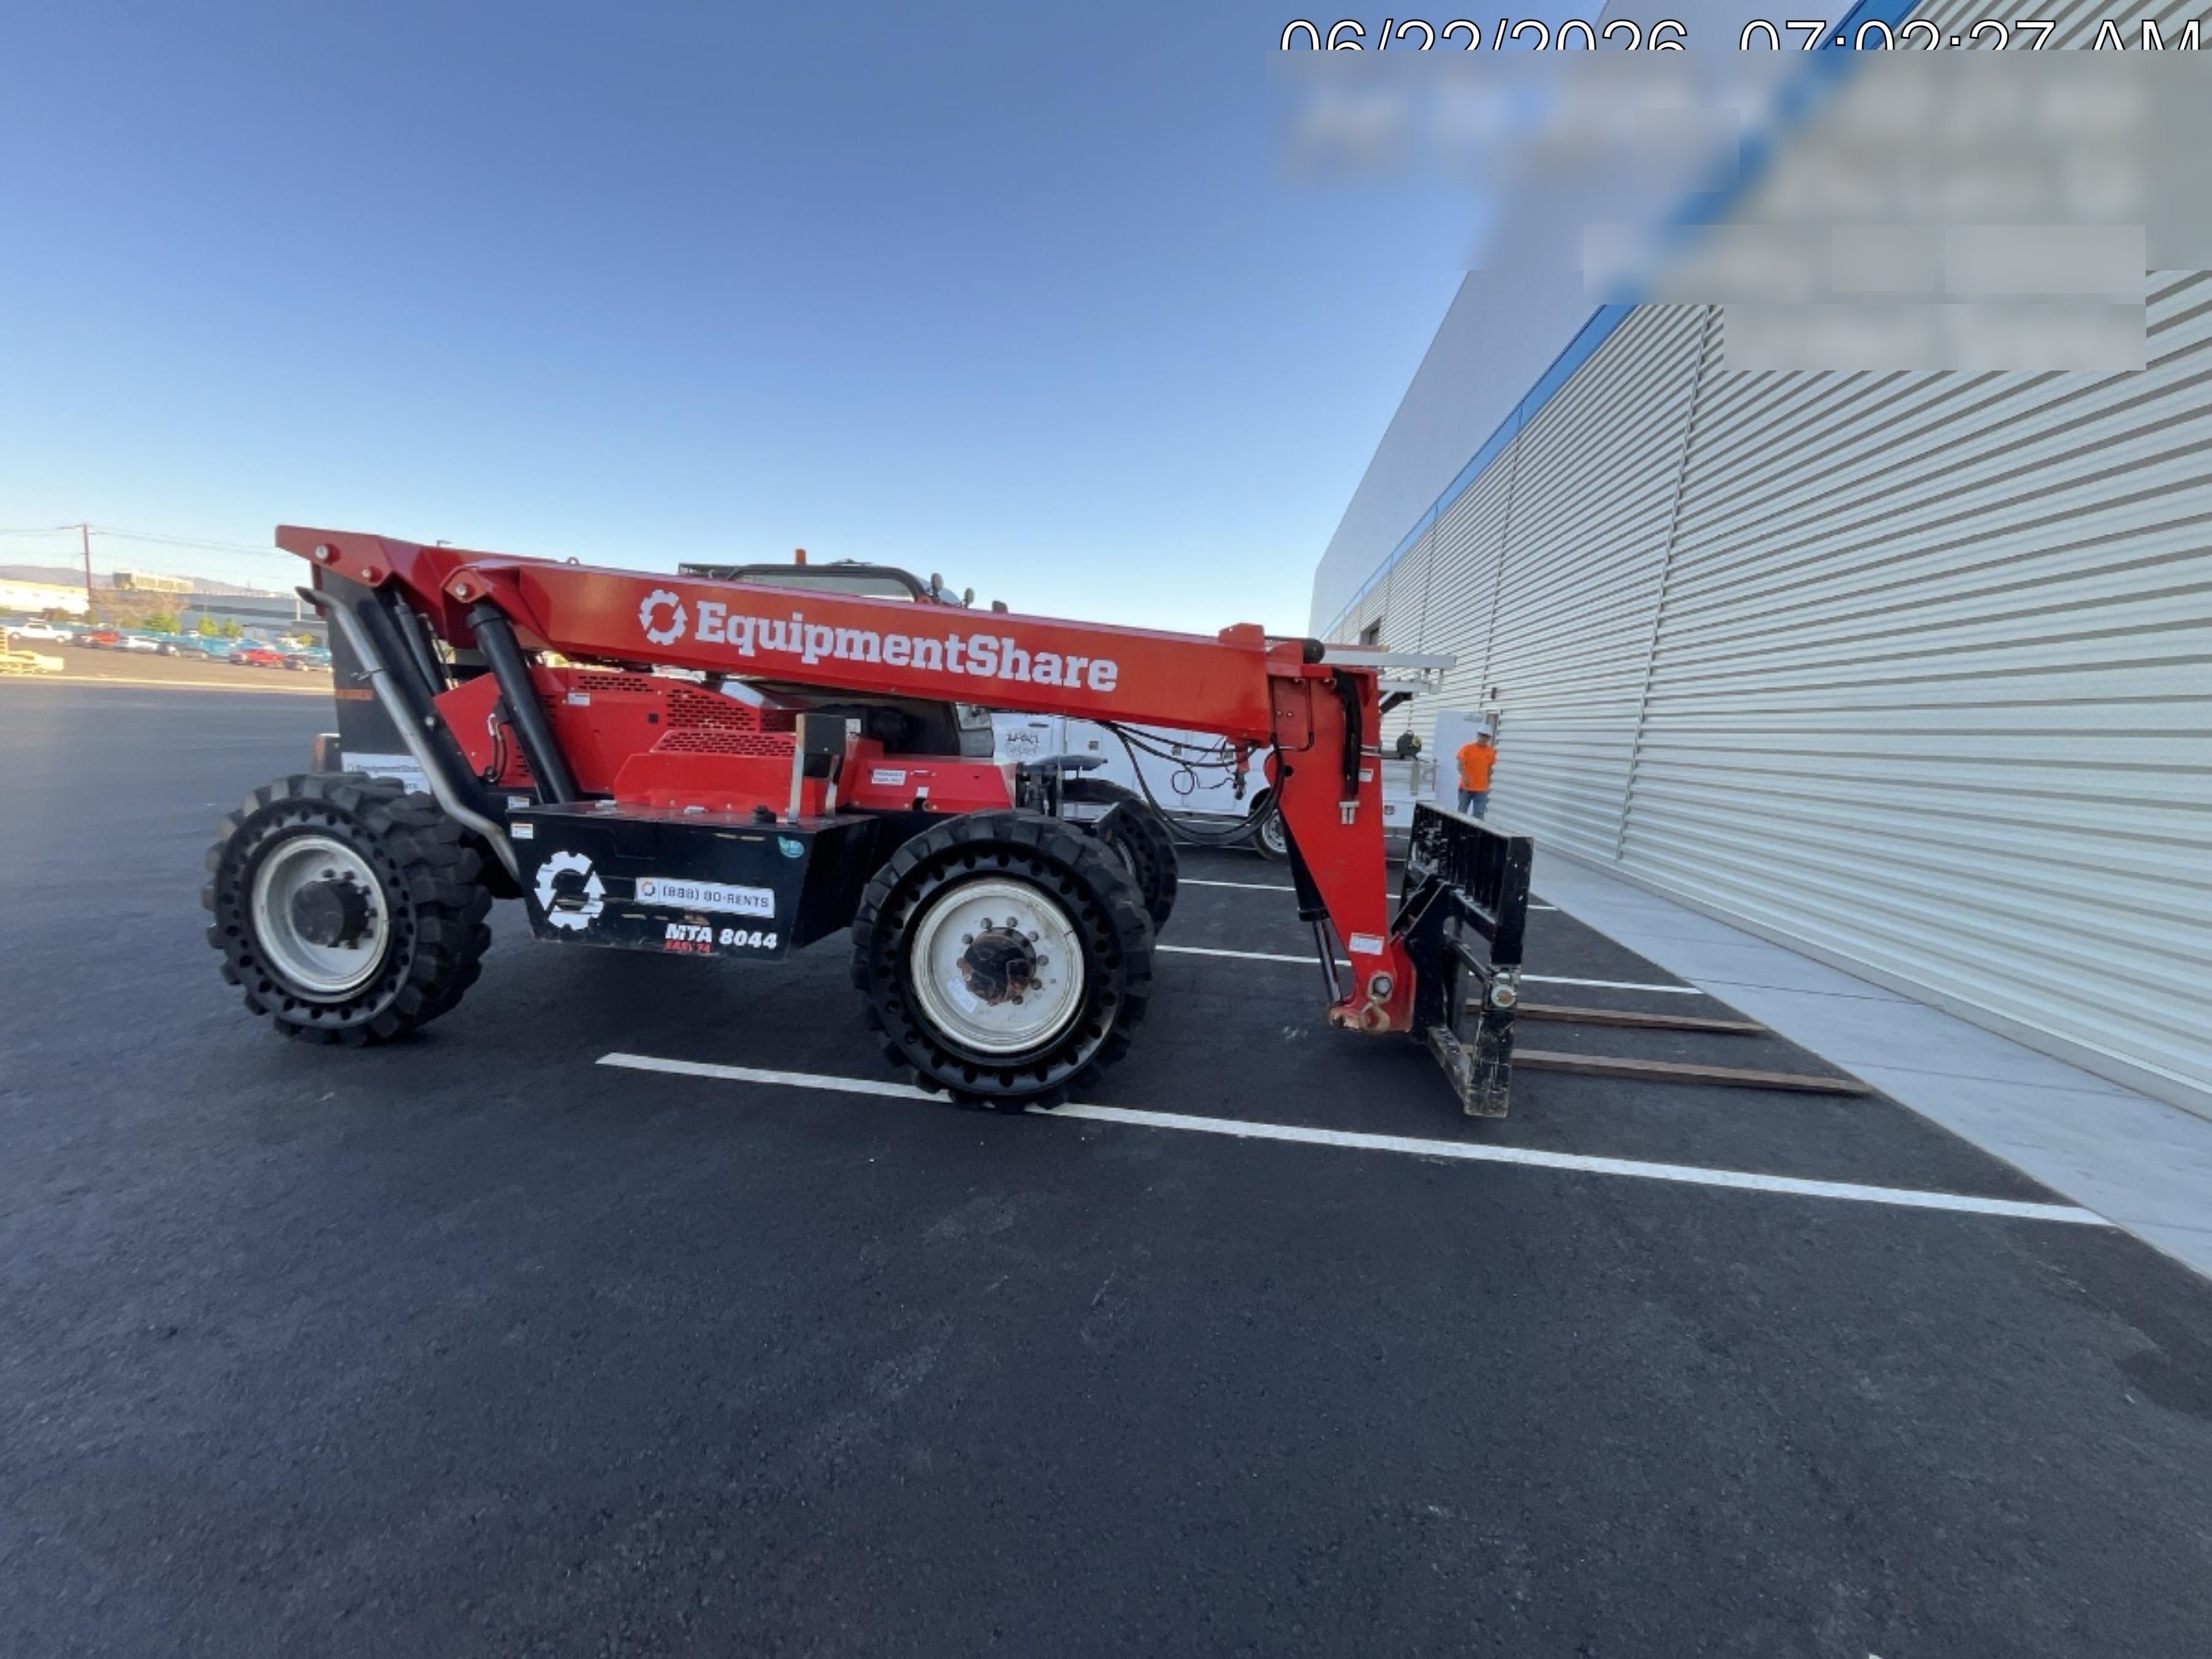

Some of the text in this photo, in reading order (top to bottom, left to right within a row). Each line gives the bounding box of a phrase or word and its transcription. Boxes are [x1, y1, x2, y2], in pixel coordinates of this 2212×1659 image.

[695, 601, 1118, 691] EquipmentShare
[665, 923, 777, 950] MTA 8044
